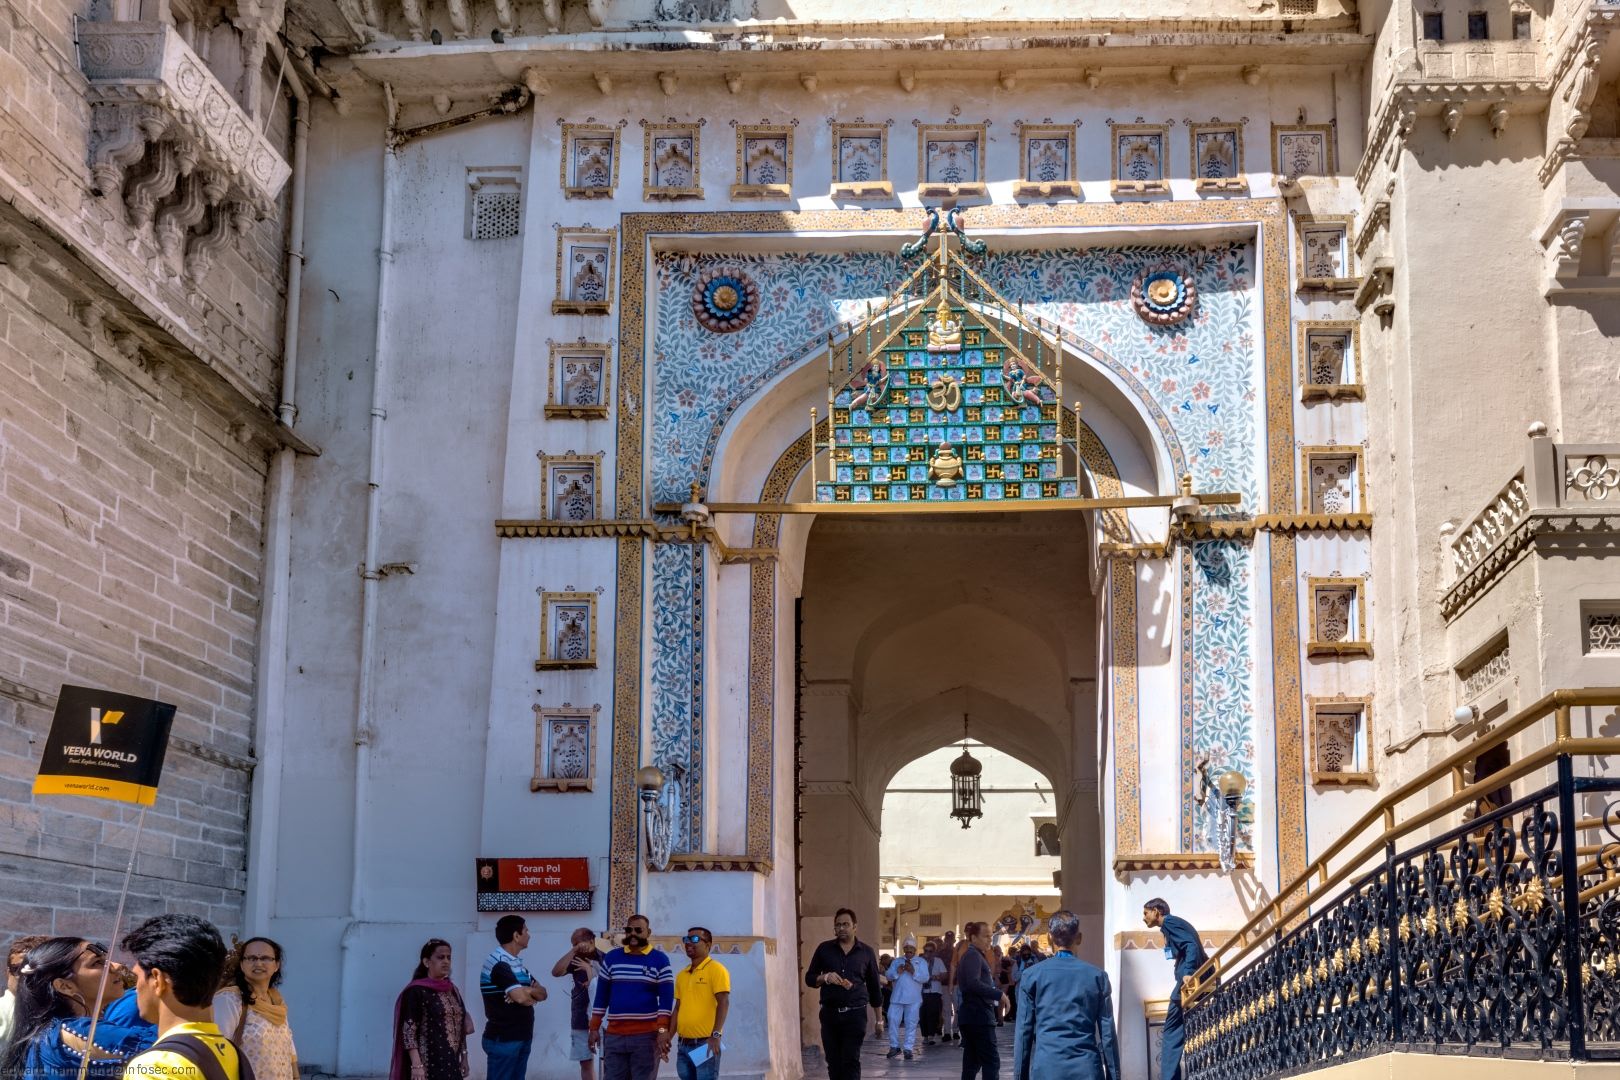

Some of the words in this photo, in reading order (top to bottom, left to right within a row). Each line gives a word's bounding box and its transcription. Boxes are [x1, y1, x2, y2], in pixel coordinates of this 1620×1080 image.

[63, 745, 91, 757] VEENA
[93, 748, 137, 763] WORLD
[64, 783, 109, 791] veenaworld.com
[517, 864, 543, 872] Toran
[546, 864, 560, 872] Pol
[519, 875, 541, 885] तोरण
[544, 875, 561, 885] पोल
